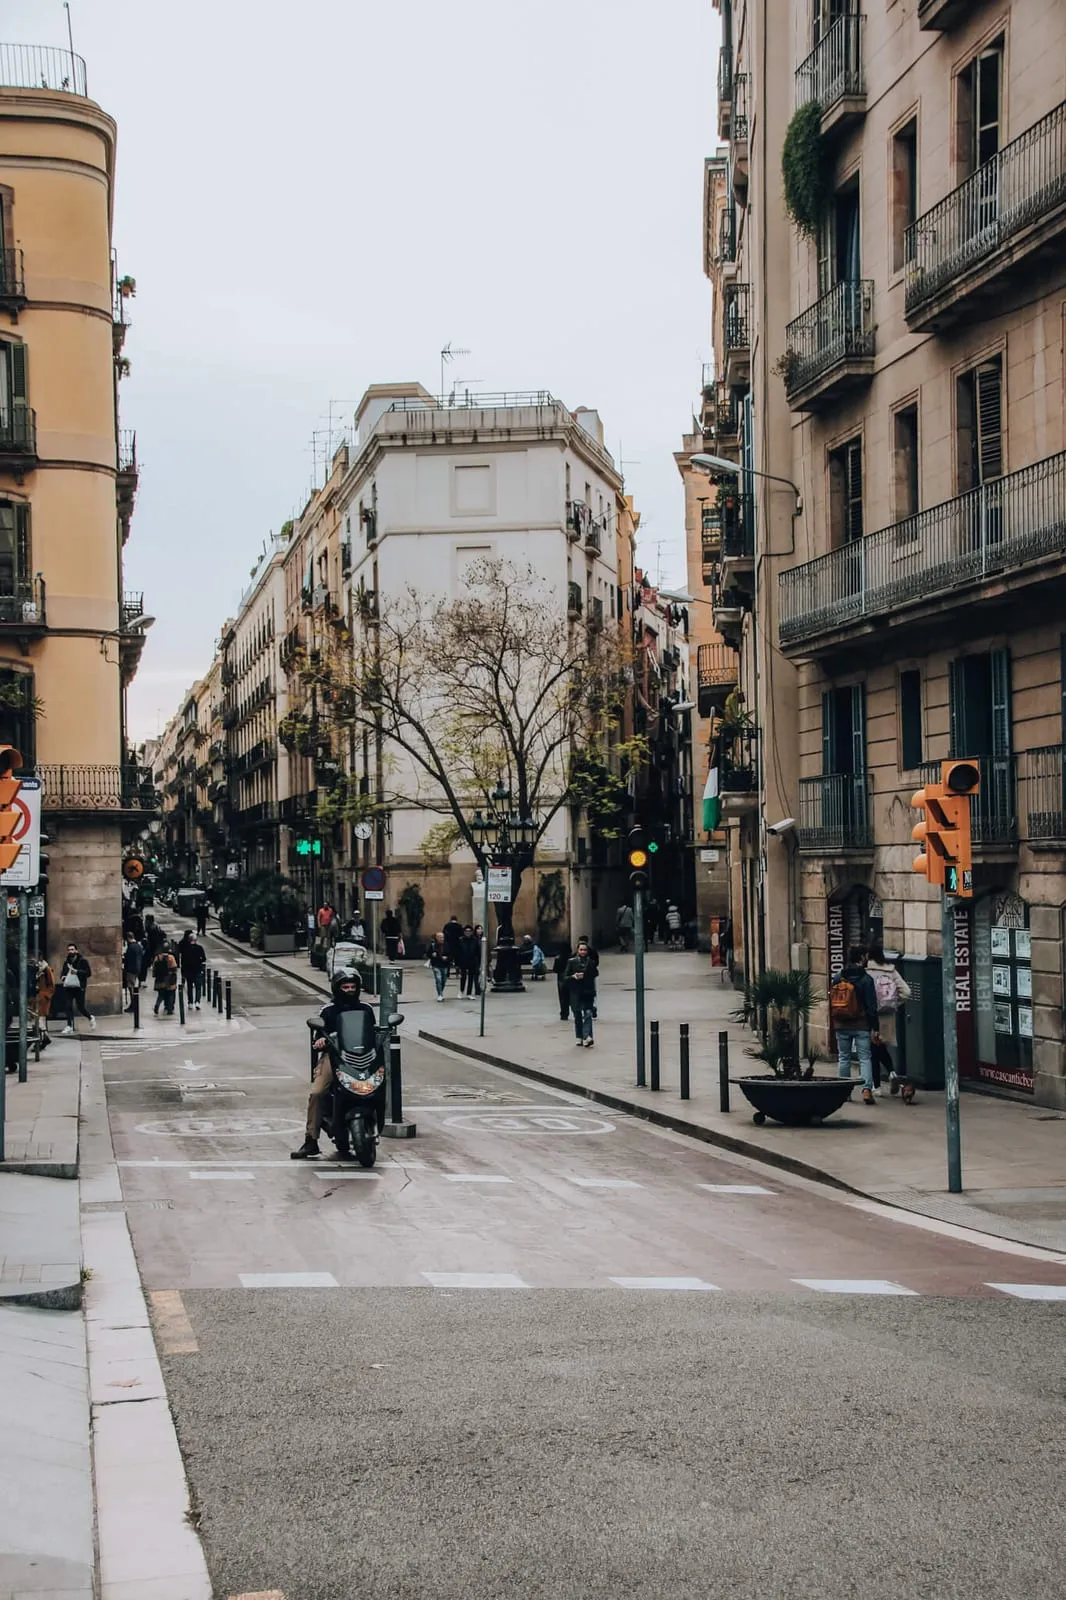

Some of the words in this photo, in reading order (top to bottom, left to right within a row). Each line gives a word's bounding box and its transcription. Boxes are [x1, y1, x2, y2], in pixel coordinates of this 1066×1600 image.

[953, 911, 970, 967] ESTATE
[955, 972, 971, 1011] REAL
[479, 1118, 582, 1130] 30
